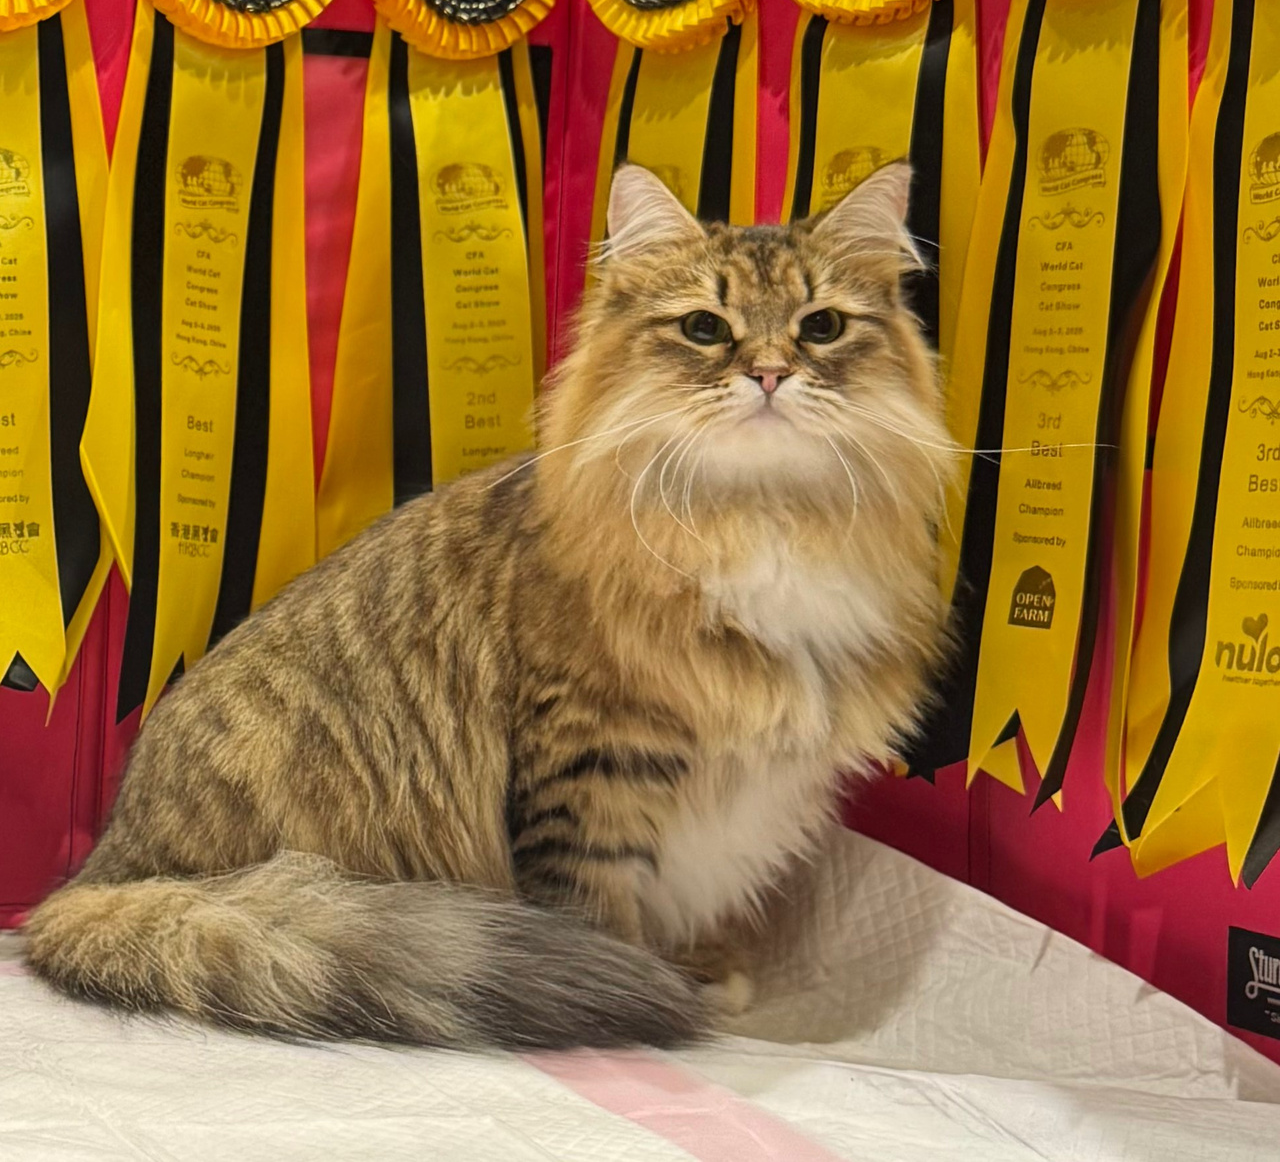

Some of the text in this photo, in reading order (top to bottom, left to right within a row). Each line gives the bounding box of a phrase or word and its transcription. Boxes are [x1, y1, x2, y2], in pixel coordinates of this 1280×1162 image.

[1253, 188, 1274, 201] World
[1055, 241, 1073, 252] CFA
[1, 257, 18, 266] Cat
[196, 250, 211, 261] CFA
[466, 251, 484, 260] CFA
[1040, 261, 1084, 272] World Cat
[1040, 282, 1081, 292] Congress
[1257, 277, 1280, 288] Worl
[185, 298, 198, 309] Cat
[1038, 302, 1054, 311] Cat
[1258, 320, 1274, 331] Cat
[466, 390, 496, 406] 2nd
[187, 415, 214, 433] Best
[464, 414, 502, 429] Best
[1037, 412, 1062, 430] 3rd
[184, 448, 214, 461] Longhair
[1030, 440, 1063, 458] Best
[1024, 478, 1062, 491] Allbreed
[1248, 474, 1280, 493] Bes
[18, 494, 30, 504] by
[208, 498, 216, 509] by
[1018, 503, 1064, 517] Champion
[1013, 531, 1066, 548] Sponsored by
[1016, 592, 1052, 608] OPEN
[1013, 607, 1051, 623] FARM
[1245, 946, 1280, 999] Stur
